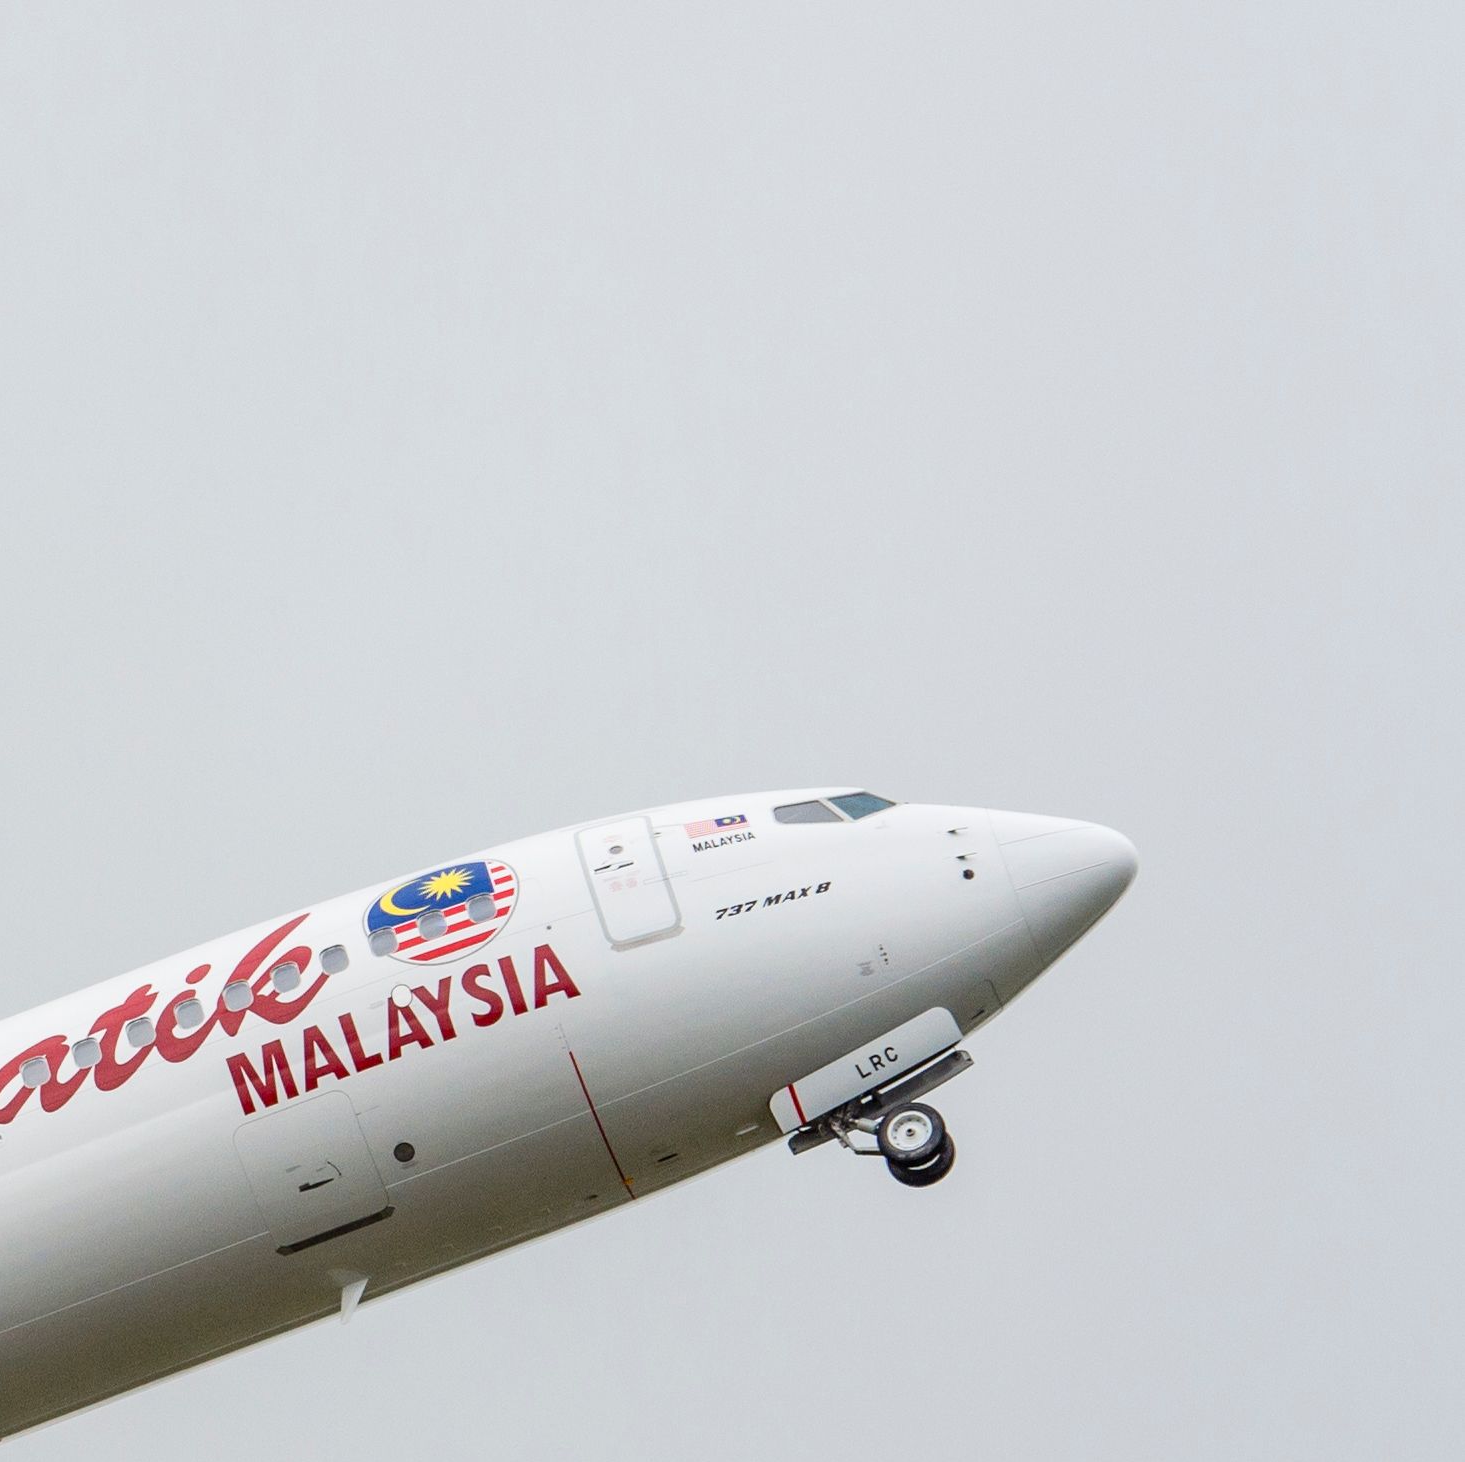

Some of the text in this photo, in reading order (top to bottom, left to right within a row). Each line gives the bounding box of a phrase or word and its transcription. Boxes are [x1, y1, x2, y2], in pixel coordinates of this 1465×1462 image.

[692, 831, 756, 853] MALAYSIA
[715, 881, 832, 921] 737 MAX 8
[226, 943, 582, 1116] MALAYSIA
[855, 1045, 899, 1080] LRC
